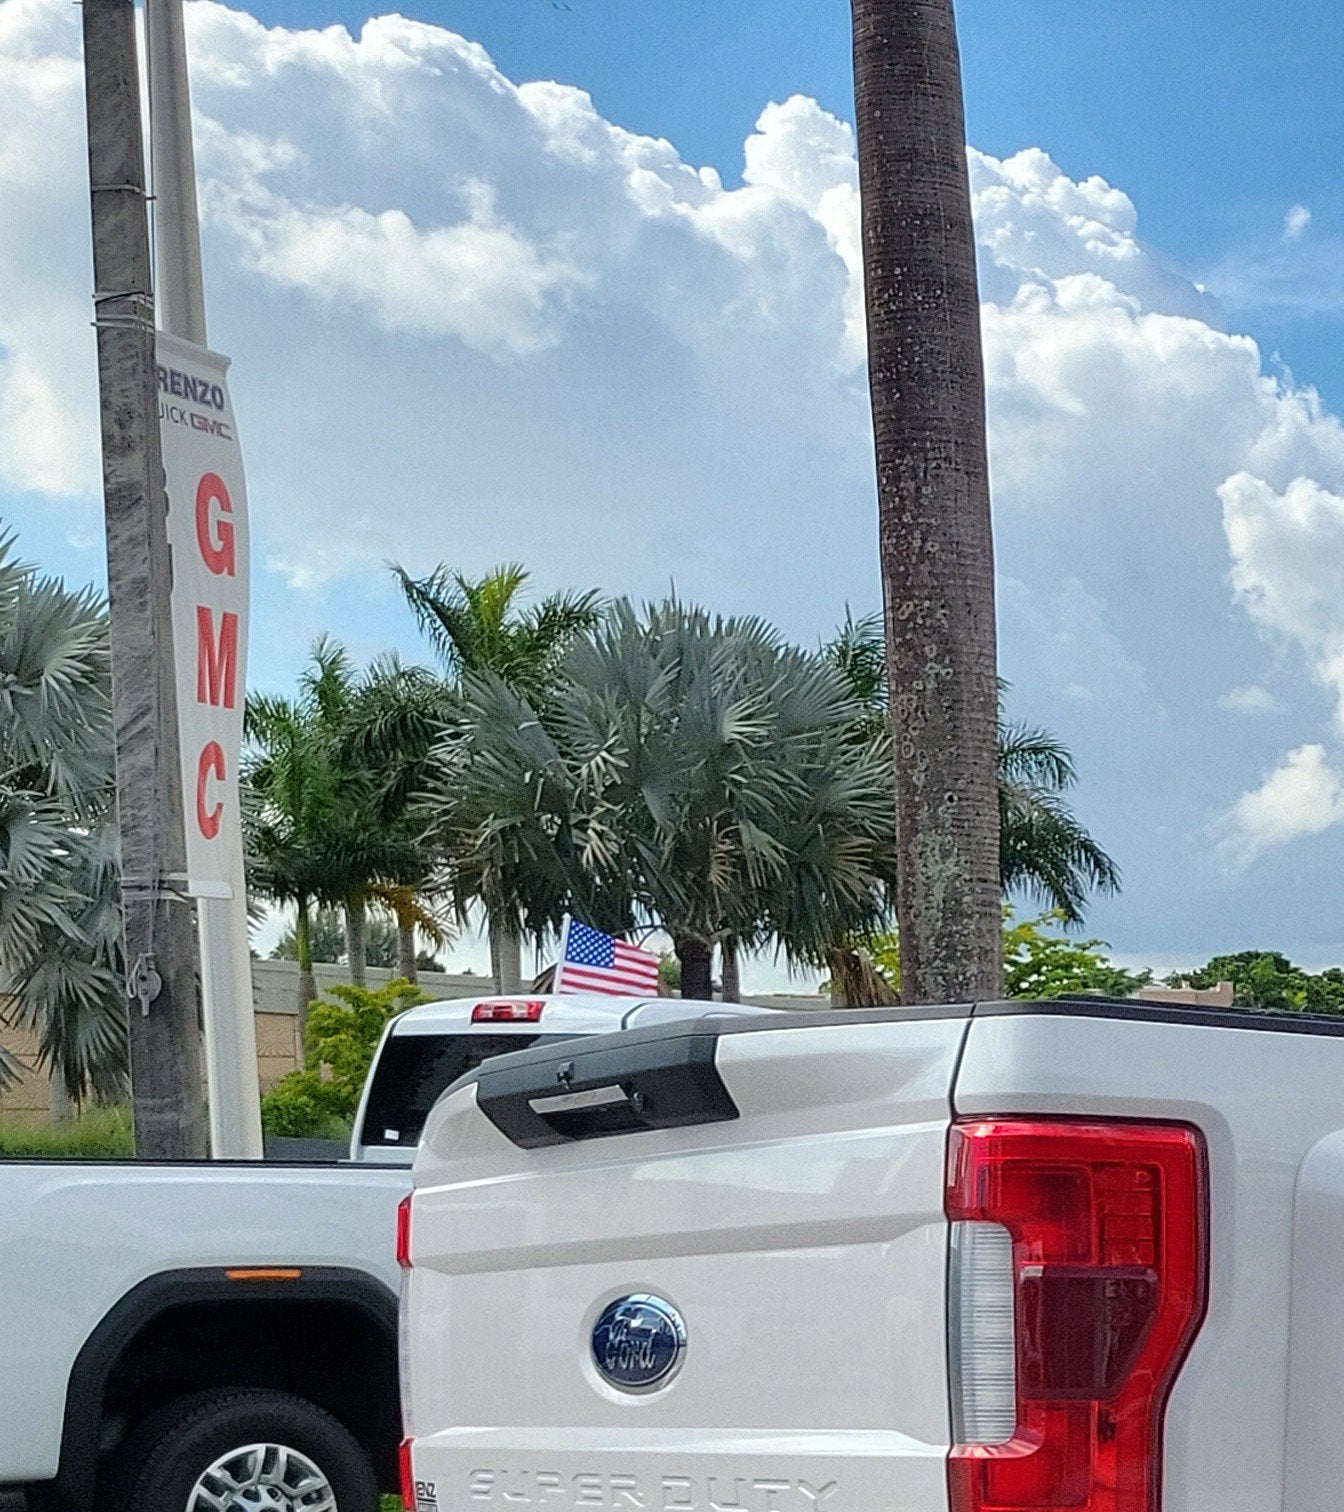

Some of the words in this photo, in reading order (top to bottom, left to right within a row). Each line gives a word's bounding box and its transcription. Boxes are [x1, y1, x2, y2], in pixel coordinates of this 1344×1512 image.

[190, 412, 232, 440] GMC
[195, 471, 239, 841] GMC
[470, 1469, 646, 1508] SUPER
